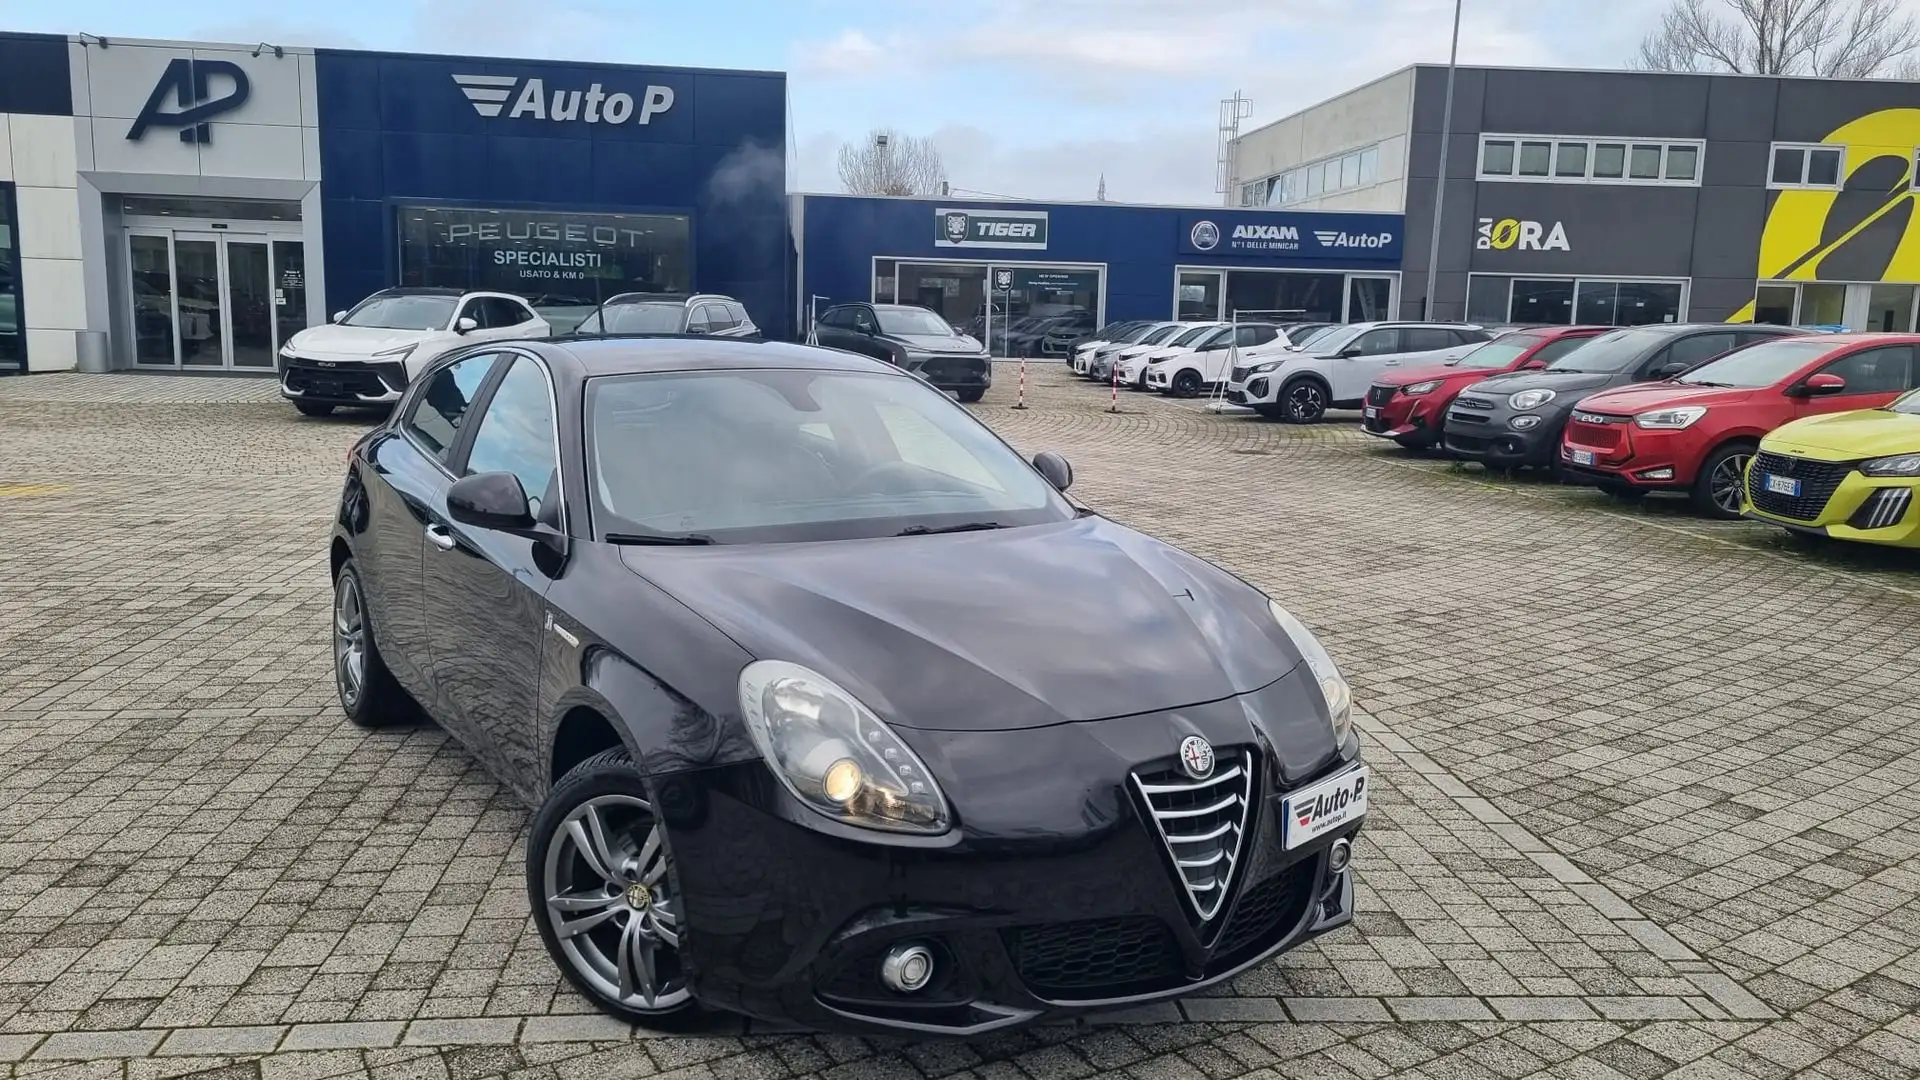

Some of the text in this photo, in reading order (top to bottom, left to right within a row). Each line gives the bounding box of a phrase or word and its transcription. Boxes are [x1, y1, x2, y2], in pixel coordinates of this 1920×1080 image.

[508, 78, 675, 125] Auto P
[448, 222, 644, 248] PEUGEOT
[977, 222, 1037, 237] TIGER
[1232, 224, 1299, 240] AIXAM
[1476, 217, 1493, 250] DAI
[1246, 241, 1267, 249] DELLE
[1268, 242, 1299, 250] MINICAR
[494, 250, 601, 268] SPECIALISTI
[519, 270, 585, 280] USATO & KM 0
[1582, 414, 1604, 424] EVO
[1311, 811, 1347, 833] www.autop.it
